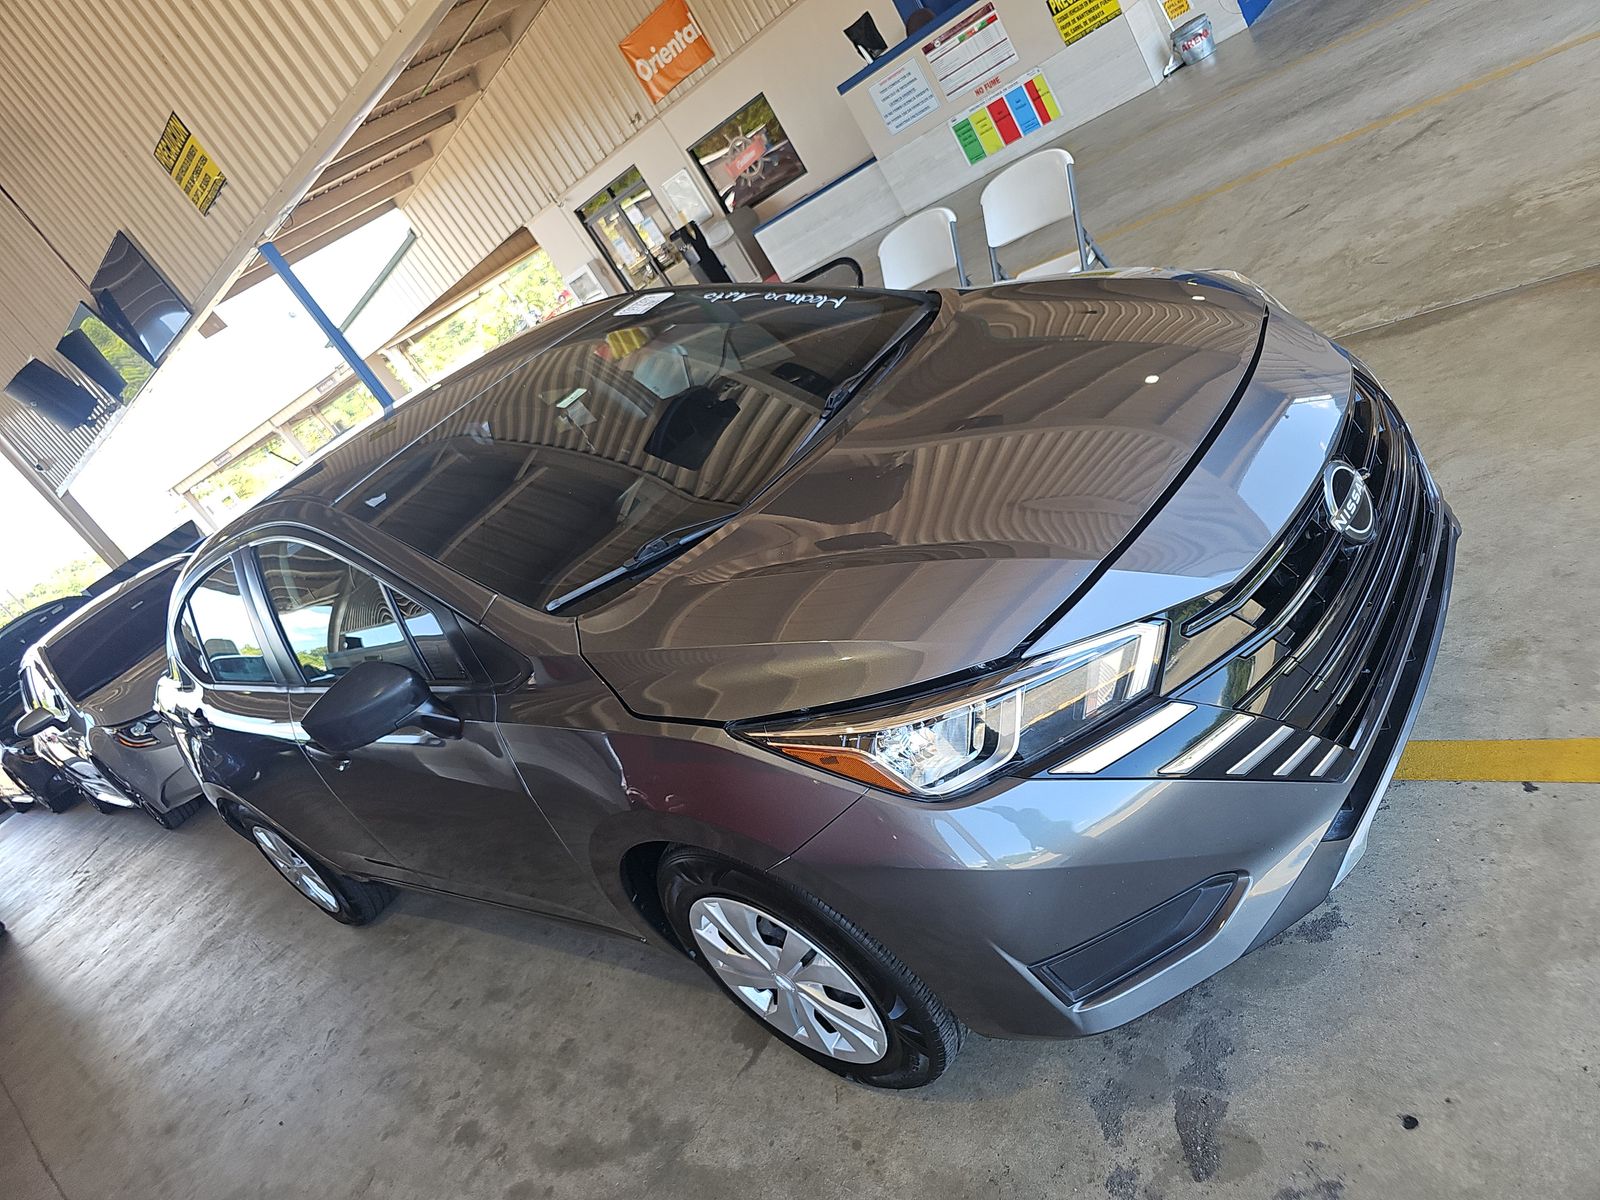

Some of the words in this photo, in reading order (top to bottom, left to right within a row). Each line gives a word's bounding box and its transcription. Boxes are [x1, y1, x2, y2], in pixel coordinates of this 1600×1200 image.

[974, 86, 984, 97] NO
[984, 76, 1001, 90] FUME
[1333, 472, 1364, 531] NISSAN
